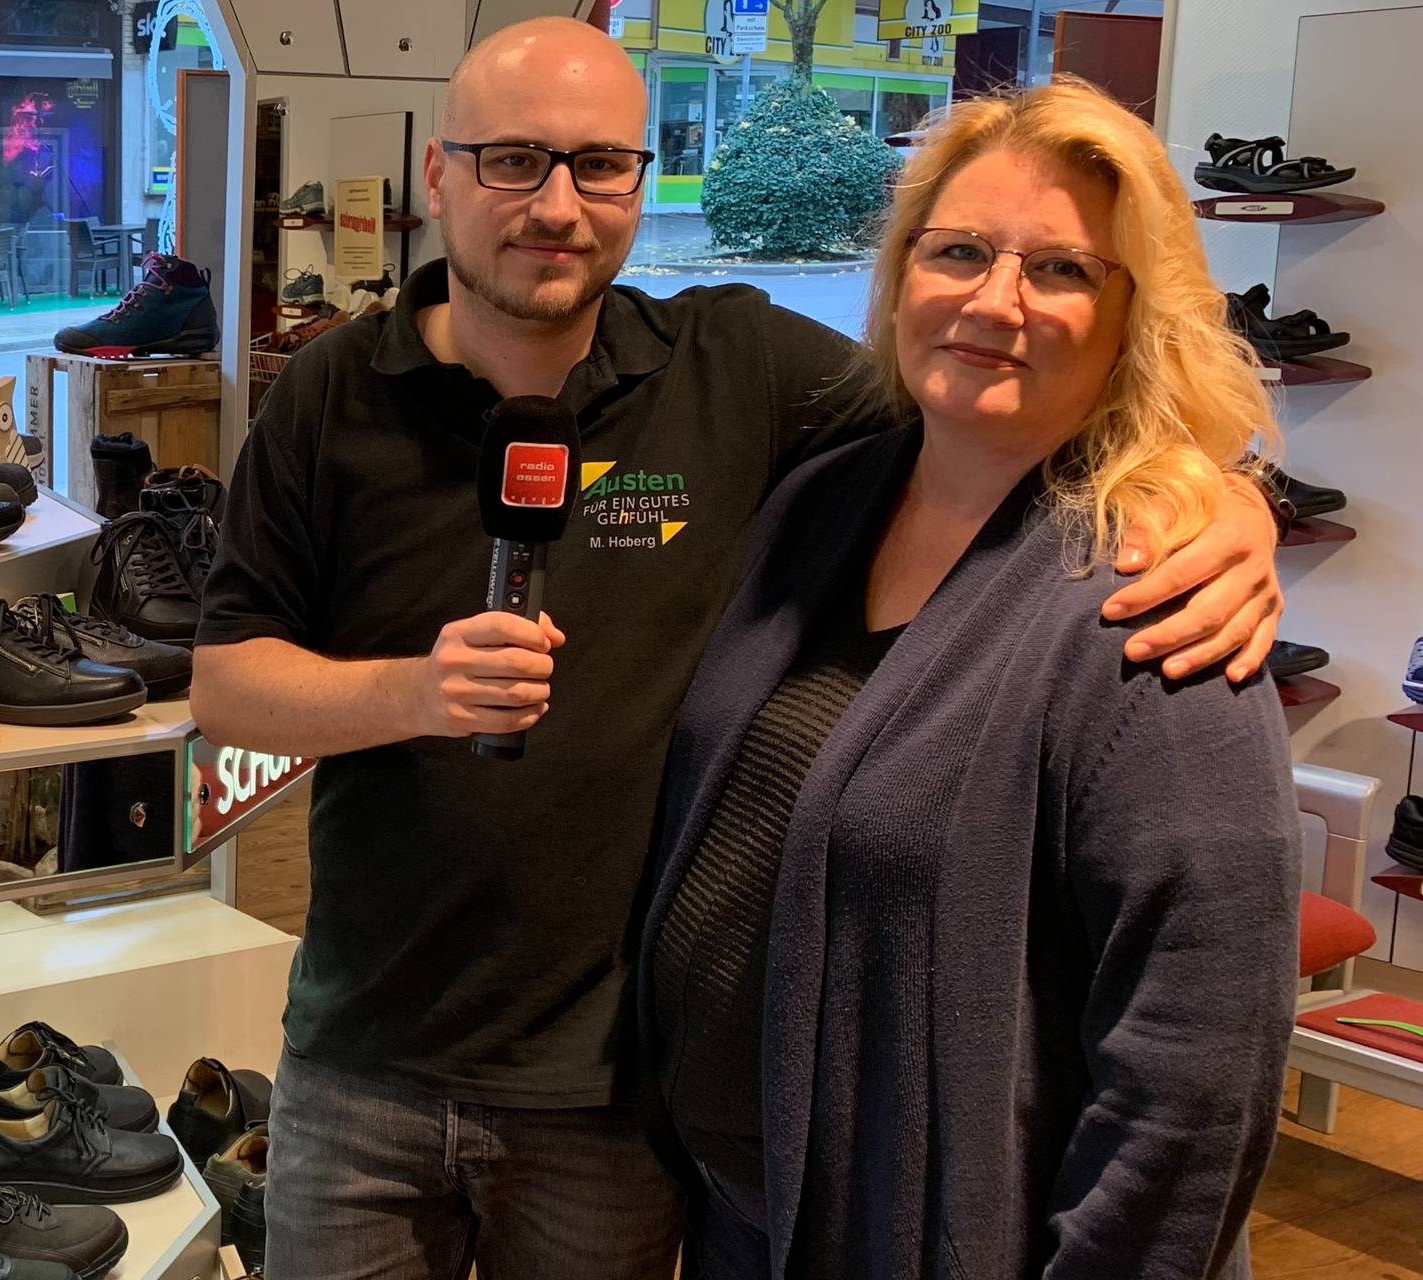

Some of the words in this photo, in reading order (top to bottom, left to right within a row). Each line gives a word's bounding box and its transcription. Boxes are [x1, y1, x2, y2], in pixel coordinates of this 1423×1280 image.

[137, 13, 166, 38] sk
[905, 25, 927, 37] CITY
[931, 24, 952, 35] ZOO
[705, 36, 727, 55] CITY
[520, 462, 555, 471] radio
[516, 474, 555, 482] essen
[583, 470, 685, 499] Austen
[583, 499, 607, 516] FÜR
[612, 497, 635, 510] EIN
[639, 493, 690, 510] GUTES
[590, 537, 604, 548] M.
[608, 536, 656, 549] Hoberg
[217, 746, 302, 815] SCH
